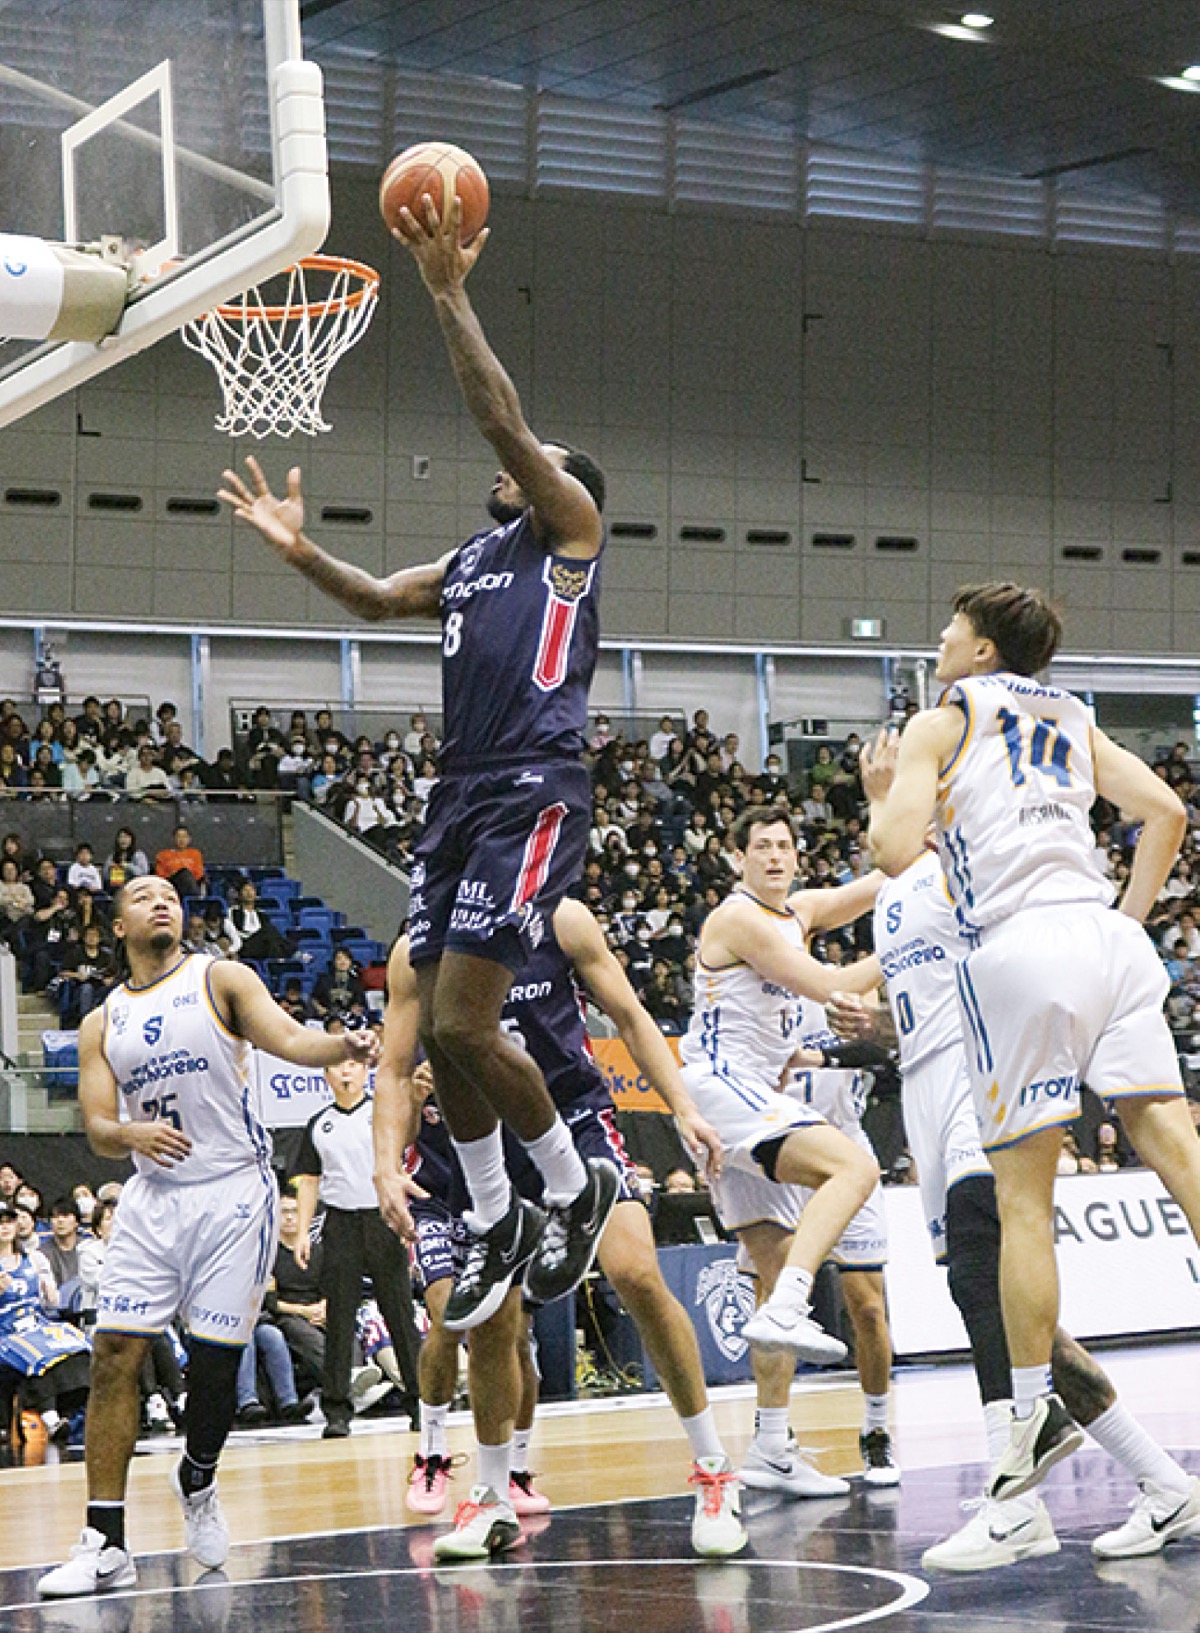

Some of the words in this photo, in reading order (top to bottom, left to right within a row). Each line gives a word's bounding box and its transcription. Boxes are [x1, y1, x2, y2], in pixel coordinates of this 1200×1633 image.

[996, 704, 1076, 789] 14
[886, 900, 902, 934] S
[143, 1015, 164, 1046] S
